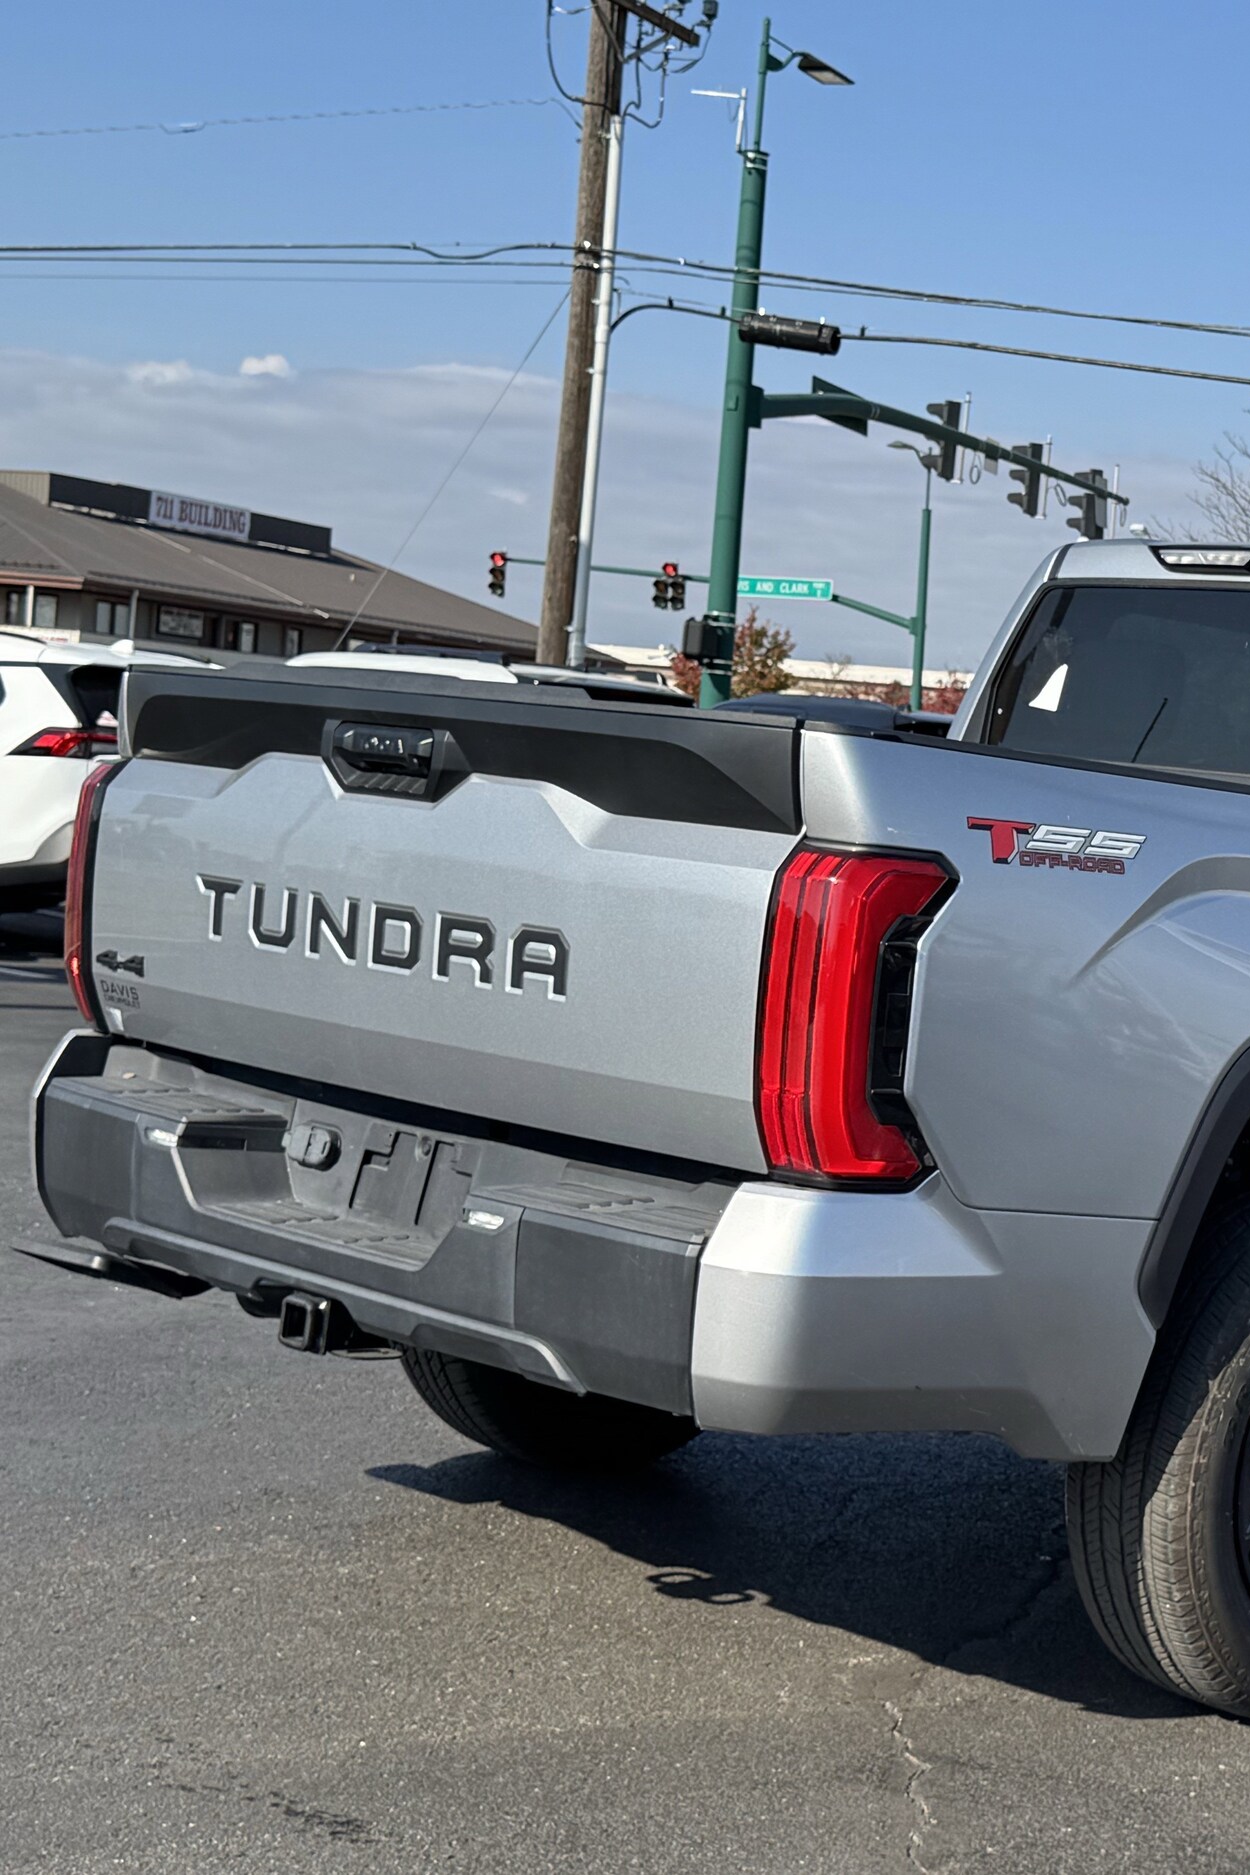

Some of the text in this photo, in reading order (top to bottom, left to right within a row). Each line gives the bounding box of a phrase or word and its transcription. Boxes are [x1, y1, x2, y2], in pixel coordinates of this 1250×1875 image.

[156, 496, 246, 534] 711 BUILDING
[755, 581, 774, 593] AND
[779, 582, 809, 595] CLARK
[1019, 851, 1126, 875] OFF-ROAD
[196, 873, 571, 1003] TUNDRA
[100, 979, 139, 1001] DAVIS
